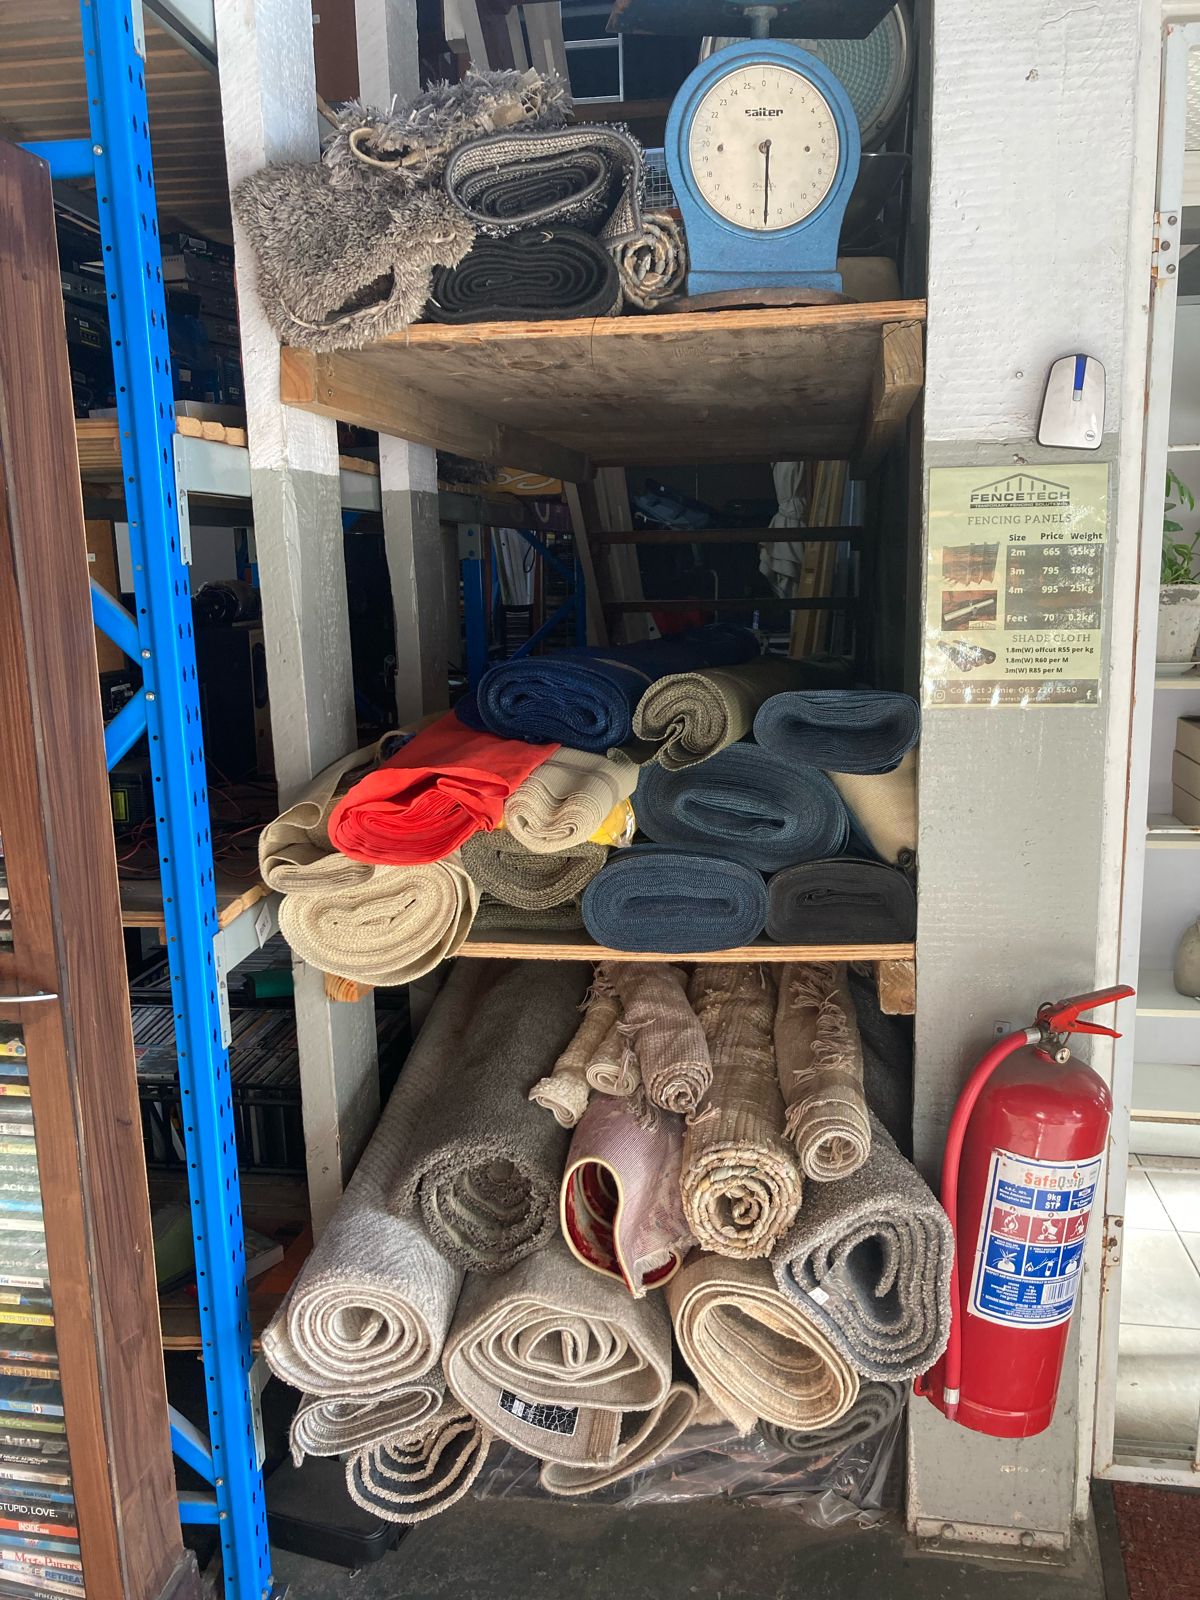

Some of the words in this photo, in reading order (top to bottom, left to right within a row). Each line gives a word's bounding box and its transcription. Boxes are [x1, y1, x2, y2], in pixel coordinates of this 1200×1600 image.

[970, 491, 1071, 502] FENCETECH
[967, 515, 1021, 526] FENCING
[1024, 513, 1073, 524] PANELS
[1009, 533, 1027, 541] Size
[1040, 531, 1064, 540] Price
[1070, 531, 1103, 542] Weight
[1010, 548, 1026, 557] 2m
[1042, 547, 1060, 556] 665
[1009, 567, 1025, 575] 3m
[1042, 566, 1060, 575] 795
[1070, 565, 1094, 576] 18kg
[1008, 586, 1024, 594] 4m
[1041, 585, 1059, 594] 995
[1069, 583, 1094, 594] 25kg
[1006, 614, 1028, 622] Feet
[1042, 613, 1055, 621] 70
[1068, 612, 1094, 623] 0.2kg
[1012, 634, 1051, 643] SHADE
[1053, 633, 1091, 643] CLOTH
[1084, 646, 1094, 654] kg
[950, 686, 985, 694] Coact
[1018, 686, 1035, 694] 063
[1055, 686, 1078, 694] 5340
[1024, 1171, 1084, 1190] SafeQuip
[1047, 1193, 1061, 1203] 9kg
[1045, 1201, 1061, 1210] STP
[31, 1506, 58, 1518] LOVE.
